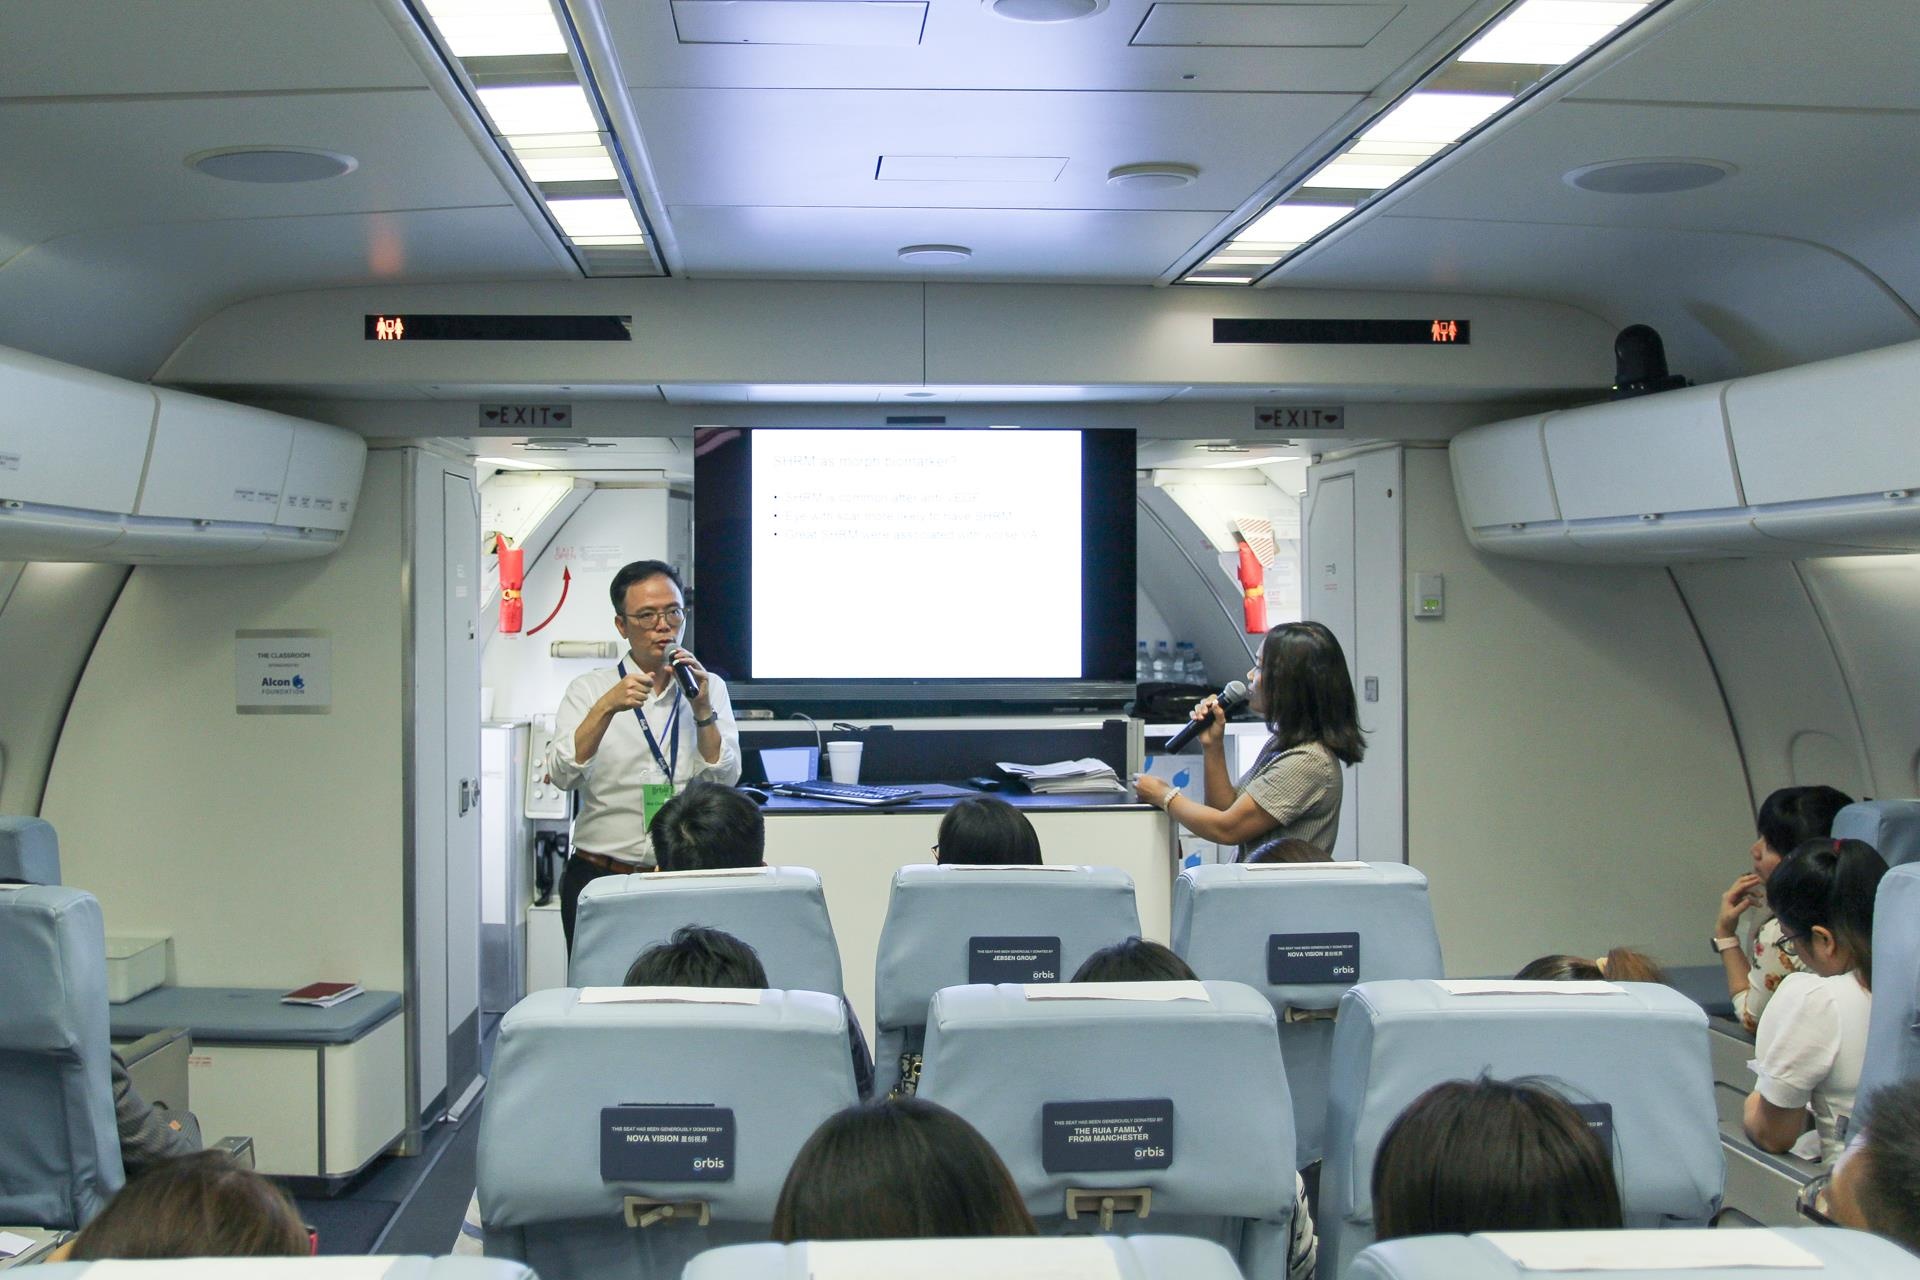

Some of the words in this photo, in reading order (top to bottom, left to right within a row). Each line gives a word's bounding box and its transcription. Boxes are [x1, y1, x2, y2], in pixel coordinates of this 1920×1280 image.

[500, 406, 550, 424] EXIT
[1274, 409, 1322, 427] EXIT
[773, 455, 816, 467] SHRM
[820, 457, 836, 467] as
[261, 677, 290, 686] Alcon
[1333, 965, 1355, 974] orbis
[1032, 971, 1055, 979] orbis
[1074, 1127, 1090, 1135] THE
[1092, 1126, 1111, 1134] RUIA
[626, 1135, 650, 1143] NOVA
[652, 1134, 679, 1143] VISION
[1068, 1135, 1092, 1143] FROM
[1093, 1133, 1149, 1142] MANCHESTER
[1134, 1146, 1165, 1158] orbis
[693, 1156, 725, 1169] orbis
